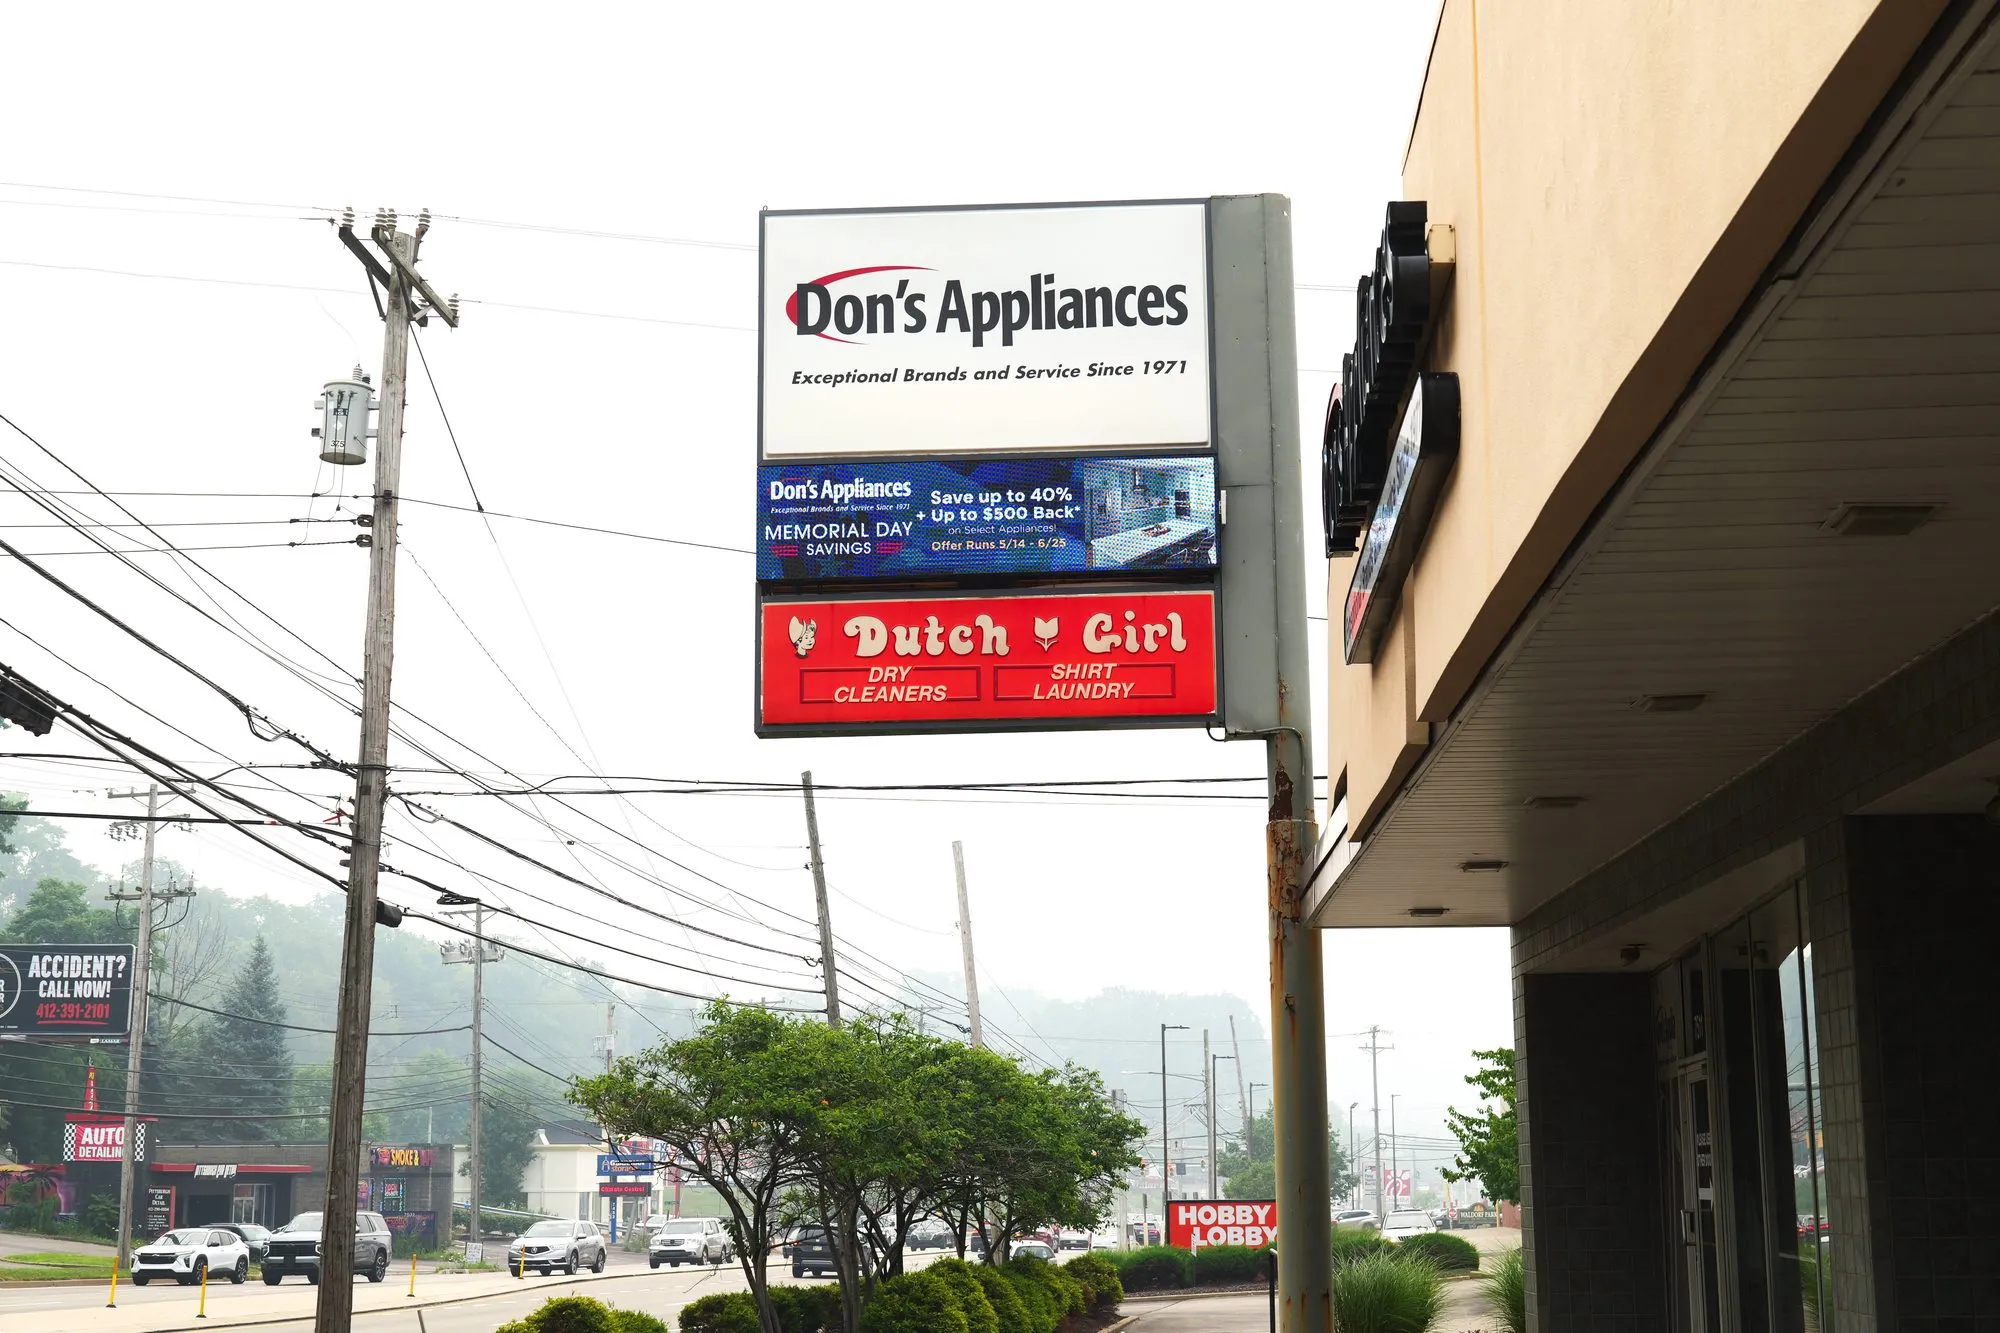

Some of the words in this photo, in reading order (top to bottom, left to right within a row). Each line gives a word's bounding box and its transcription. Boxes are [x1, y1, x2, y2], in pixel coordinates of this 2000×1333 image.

[797, 279, 927, 335] Don's
[936, 273, 1188, 347] Appliances
[792, 368, 898, 387] Exceptional
[904, 367, 967, 382] Brands
[974, 365, 1010, 380] and
[1015, 364, 1080, 379] Service
[1087, 362, 1134, 377] Since
[1143, 360, 1187, 374] 1971
[770, 479, 818, 500] Don's
[821, 477, 911, 503] Appliances
[931, 490, 974, 505] Save
[978, 492, 1002, 506] up
[1006, 489, 1026, 503] to
[1030, 487, 1073, 502] 40%
[770, 505, 809, 515] Exceptional
[811, 505, 834, 513] Brands
[835, 504, 849, 512] and
[850, 503, 874, 511] Service
[876, 503, 894, 511] Since
[916, 510, 926, 521] +
[931, 508, 955, 523] Up
[960, 508, 978, 521] to
[983, 506, 1028, 521] $500
[765, 523, 870, 541] MEMORIAL
[876, 521, 913, 538] DAY
[964, 525, 995, 534] Select
[998, 523, 1057, 534] Appliances!
[806, 541, 872, 556] SAVINGS
[931, 540, 963, 550] Offer
[966, 540, 996, 549] Runs
[999, 538, 1026, 549] 5/14
[1038, 537, 1067, 549] 6/25
[843, 613, 1011, 657] Dutch
[1083, 610, 1188, 654] Girl
[868, 665, 914, 683] DRY
[1050, 663, 1119, 680] SHIRT
[834, 685, 948, 704] CLEANERS
[1033, 682, 1136, 700] LAUNDRY
[28, 955, 127, 978] ACCIDENT?
[38, 980, 71, 998] CALL
[74, 980, 112, 998] NOW!
[36, 1002, 111, 1018] 412-391-2101
[81, 1127, 125, 1145] AUTO
[391, 1149, 413, 1166] SMOKE
[413, 1149, 419, 1166] &
[1178, 1205, 1272, 1226] HOBBY
[1192, 1226, 1278, 1247] LOBBY
